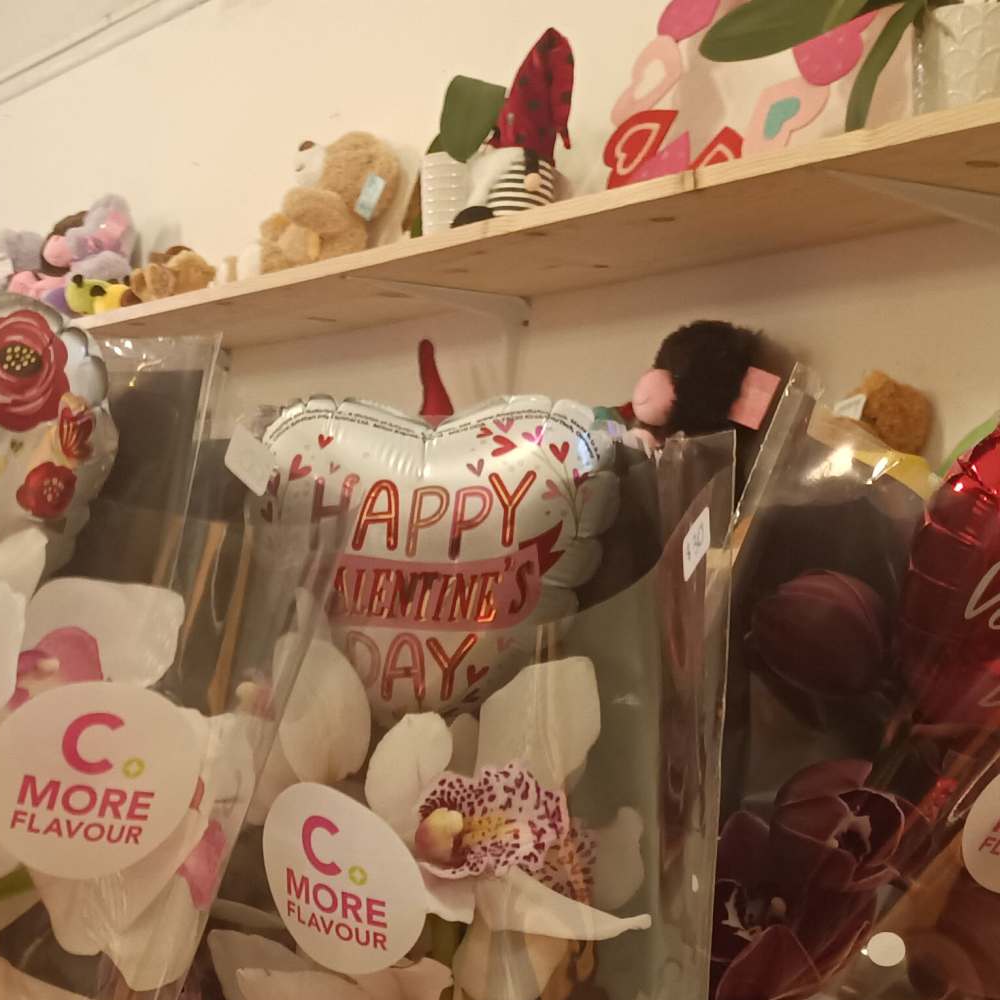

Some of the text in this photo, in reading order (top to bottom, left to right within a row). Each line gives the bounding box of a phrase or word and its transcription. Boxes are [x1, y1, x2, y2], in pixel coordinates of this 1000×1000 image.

[309, 470, 537, 561] HAPPY
[346, 632, 478, 701] DAY
[16, 773, 156, 823] MORE
[10, 809, 144, 846] FLAVOUR
[286, 866, 389, 930] MORE
[286, 900, 389, 952] FLAVOUR
